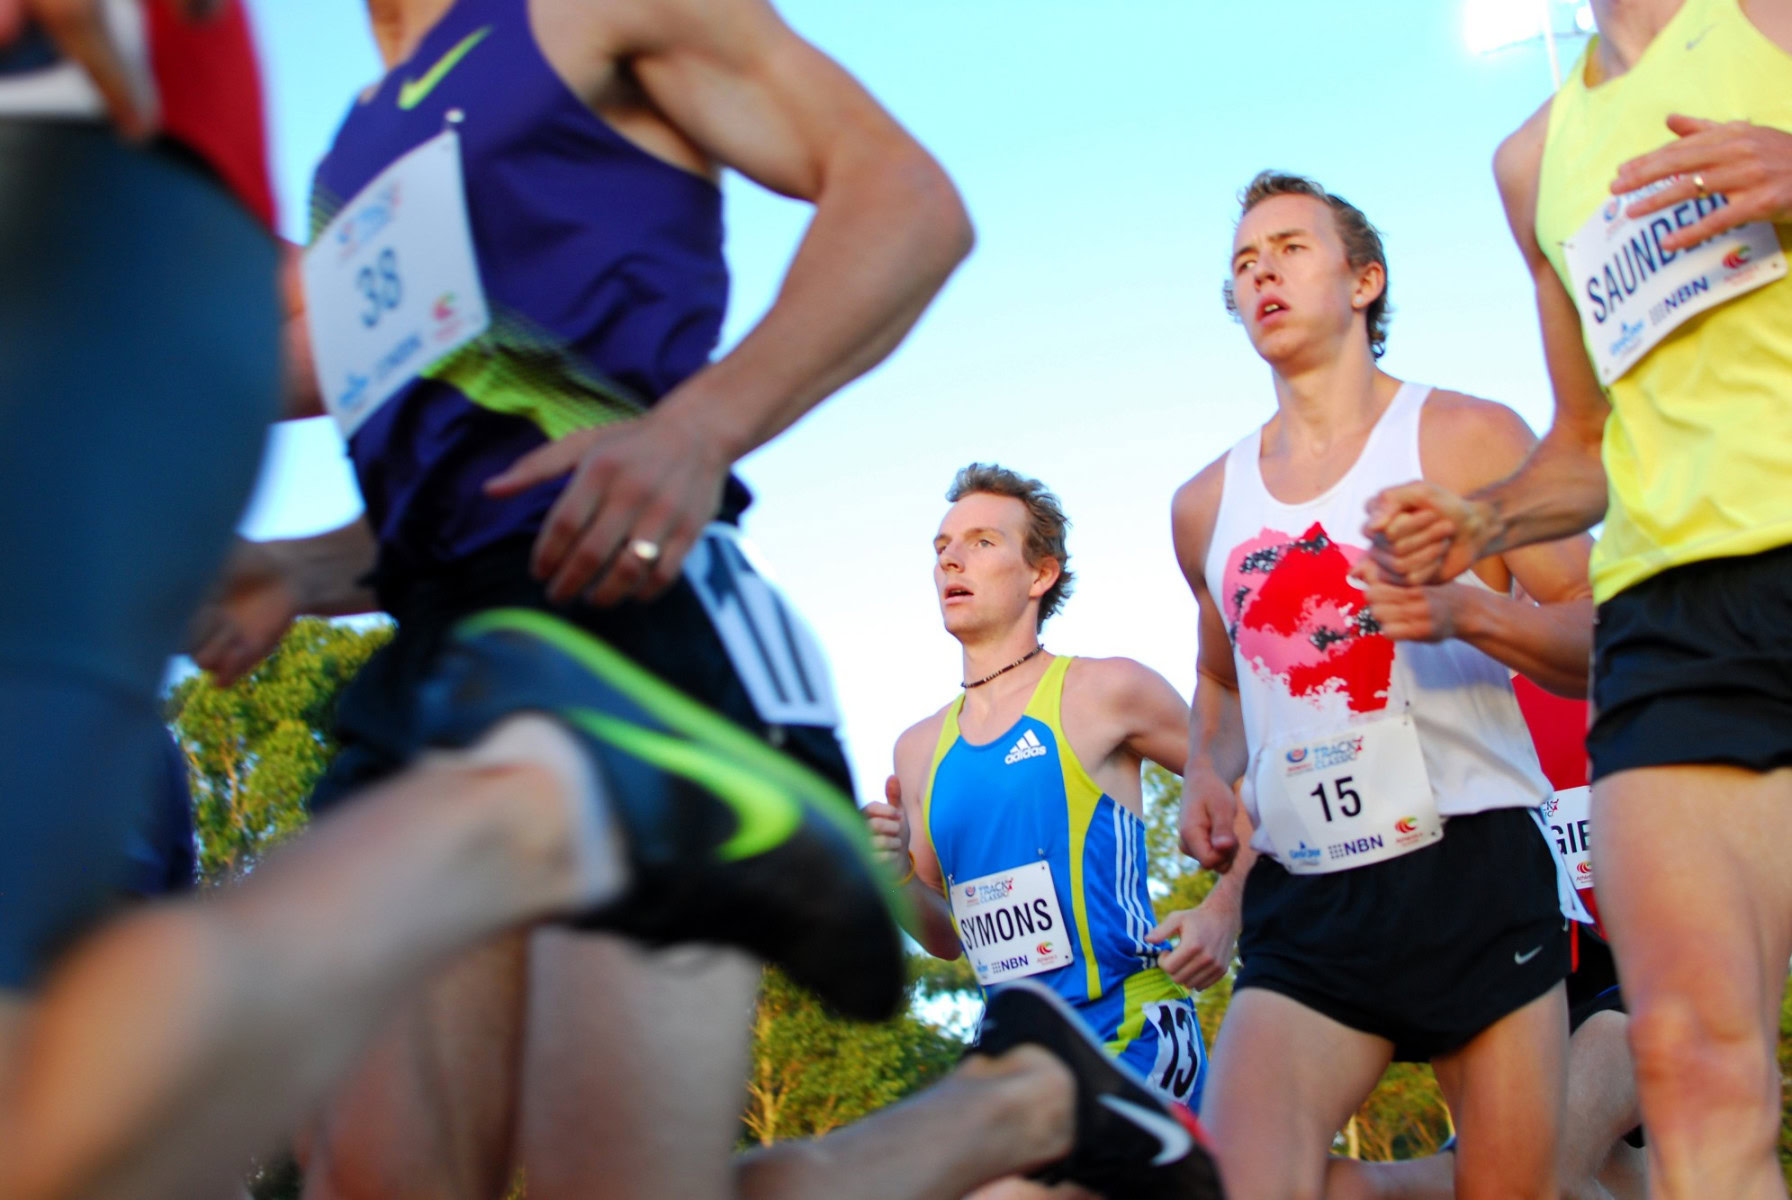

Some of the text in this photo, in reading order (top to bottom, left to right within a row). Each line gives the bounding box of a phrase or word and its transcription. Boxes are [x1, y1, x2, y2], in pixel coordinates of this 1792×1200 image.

[1586, 192, 1747, 324] SAUNDER
[1665, 276, 1710, 316] NBN
[1004, 745, 1048, 765] adidas
[1314, 741, 1356, 758] TRACK
[1310, 776, 1362, 822] 15
[1344, 834, 1384, 856] NBN
[979, 880, 1010, 896] TRACK
[960, 898, 1053, 951] SYMONS
[1001, 954, 1029, 972] NBN
[1158, 1005, 1198, 1097] 13
